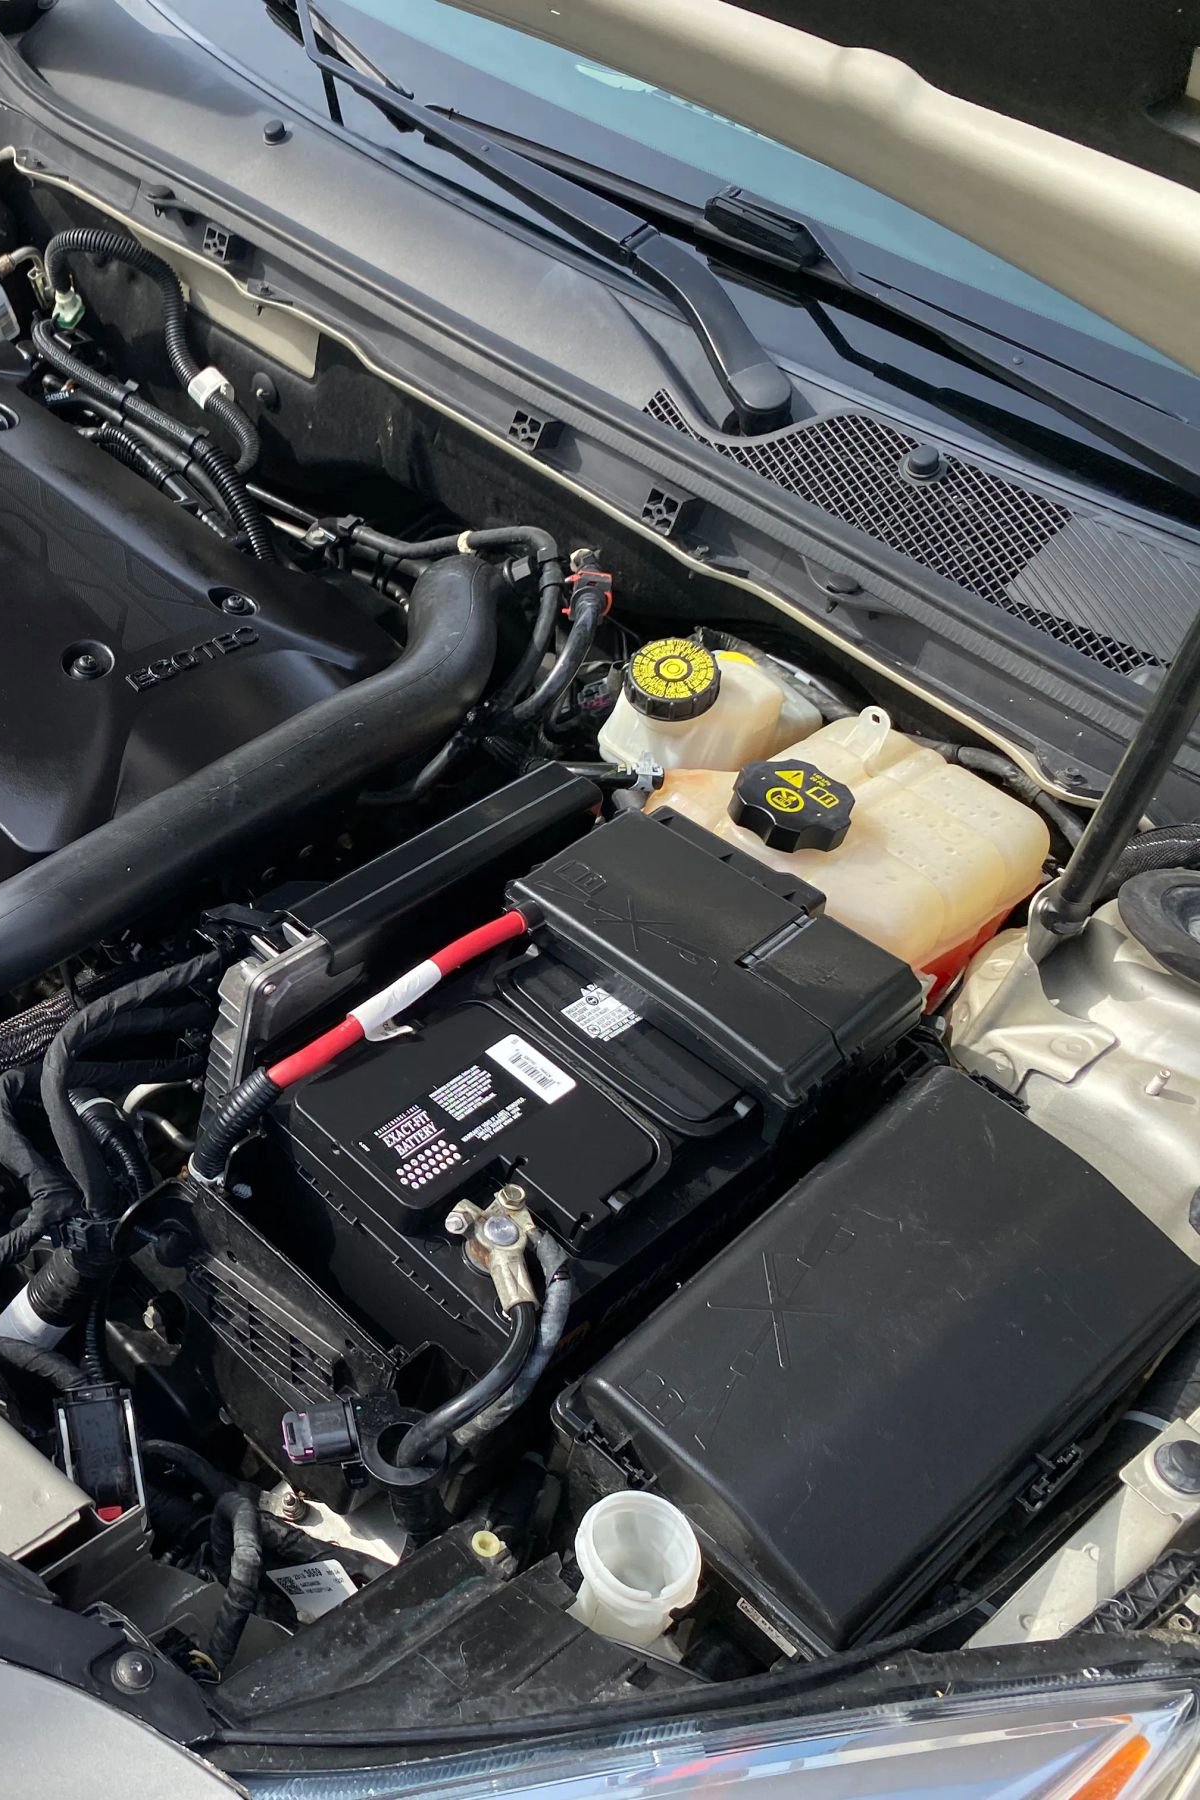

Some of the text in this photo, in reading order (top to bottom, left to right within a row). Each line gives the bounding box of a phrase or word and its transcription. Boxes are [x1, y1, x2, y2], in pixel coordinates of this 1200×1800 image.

[125, 626, 259, 691] ECOTEC
[373, 1104, 420, 1136] MAINTENANCE-FREE
[382, 1110, 430, 1148] EXACT-FIT
[394, 1121, 437, 1156] BATTERY
